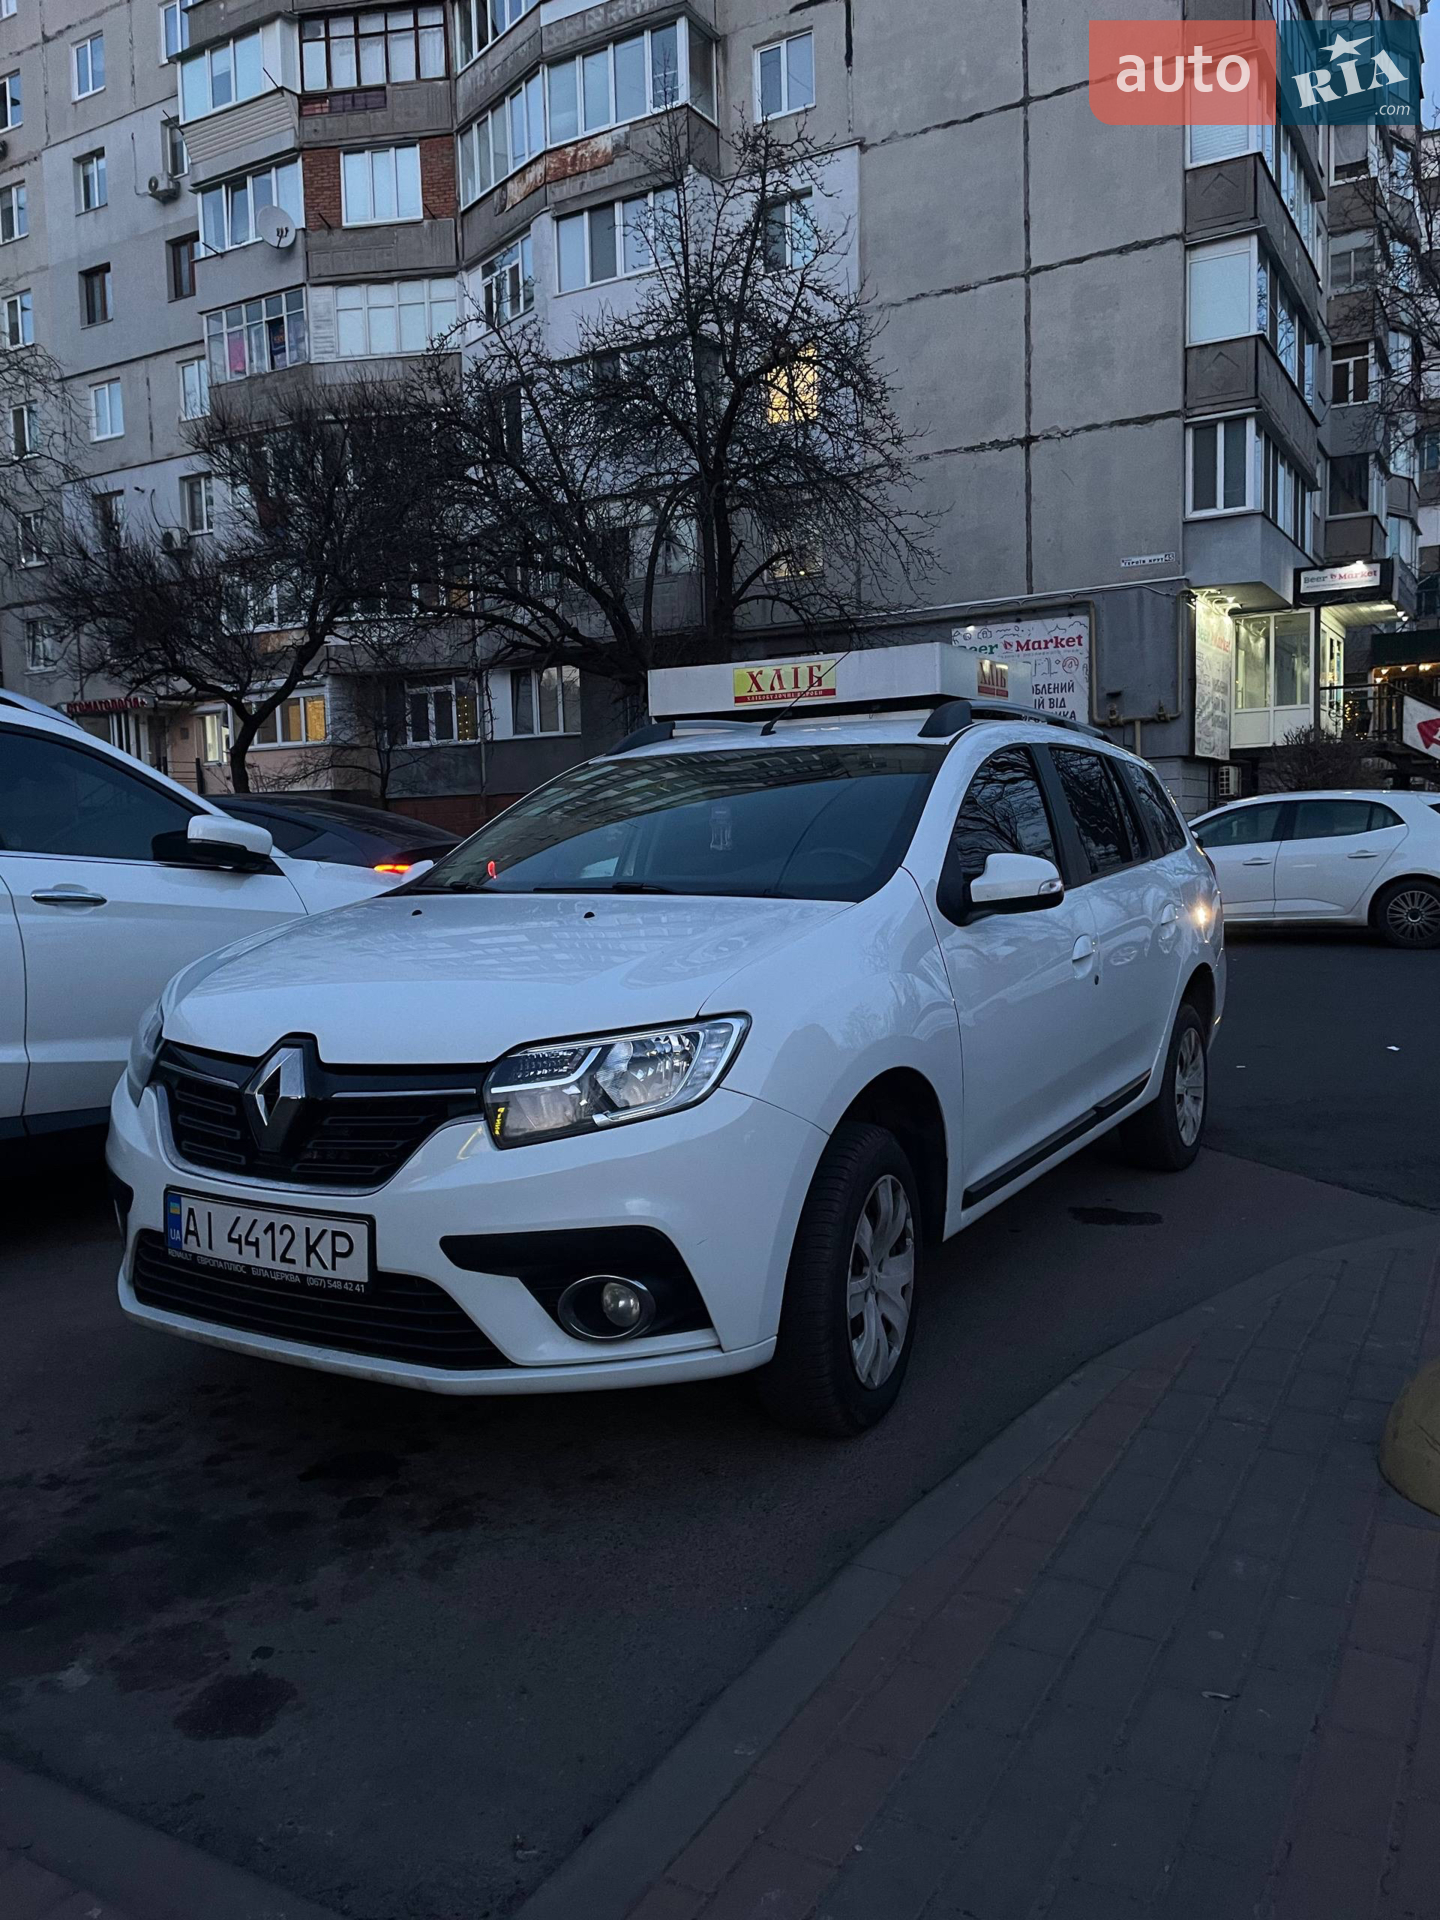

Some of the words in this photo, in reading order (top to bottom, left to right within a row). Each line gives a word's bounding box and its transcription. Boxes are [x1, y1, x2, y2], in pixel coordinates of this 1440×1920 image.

[1165, 553, 1175, 561] 45
[1303, 576, 1328, 584] Beer
[1338, 569, 1378, 581] Market
[1015, 634, 1084, 652] Market
[746, 664, 823, 693] ХЛІБ
[1048, 697, 1067, 709] ВІД
[169, 1228, 181, 1241] UA
[227, 1216, 296, 1265] 4412
[305, 1226, 355, 1271] KP
[251, 1266, 270, 1279] БІЛА
[270, 1268, 301, 1284] ЦЕРКВА
[306, 1276, 326, 1288] (067)
[327, 1278, 343, 1290] 548
[344, 1282, 354, 1292] 42
[355, 1283, 365, 1293] 41
